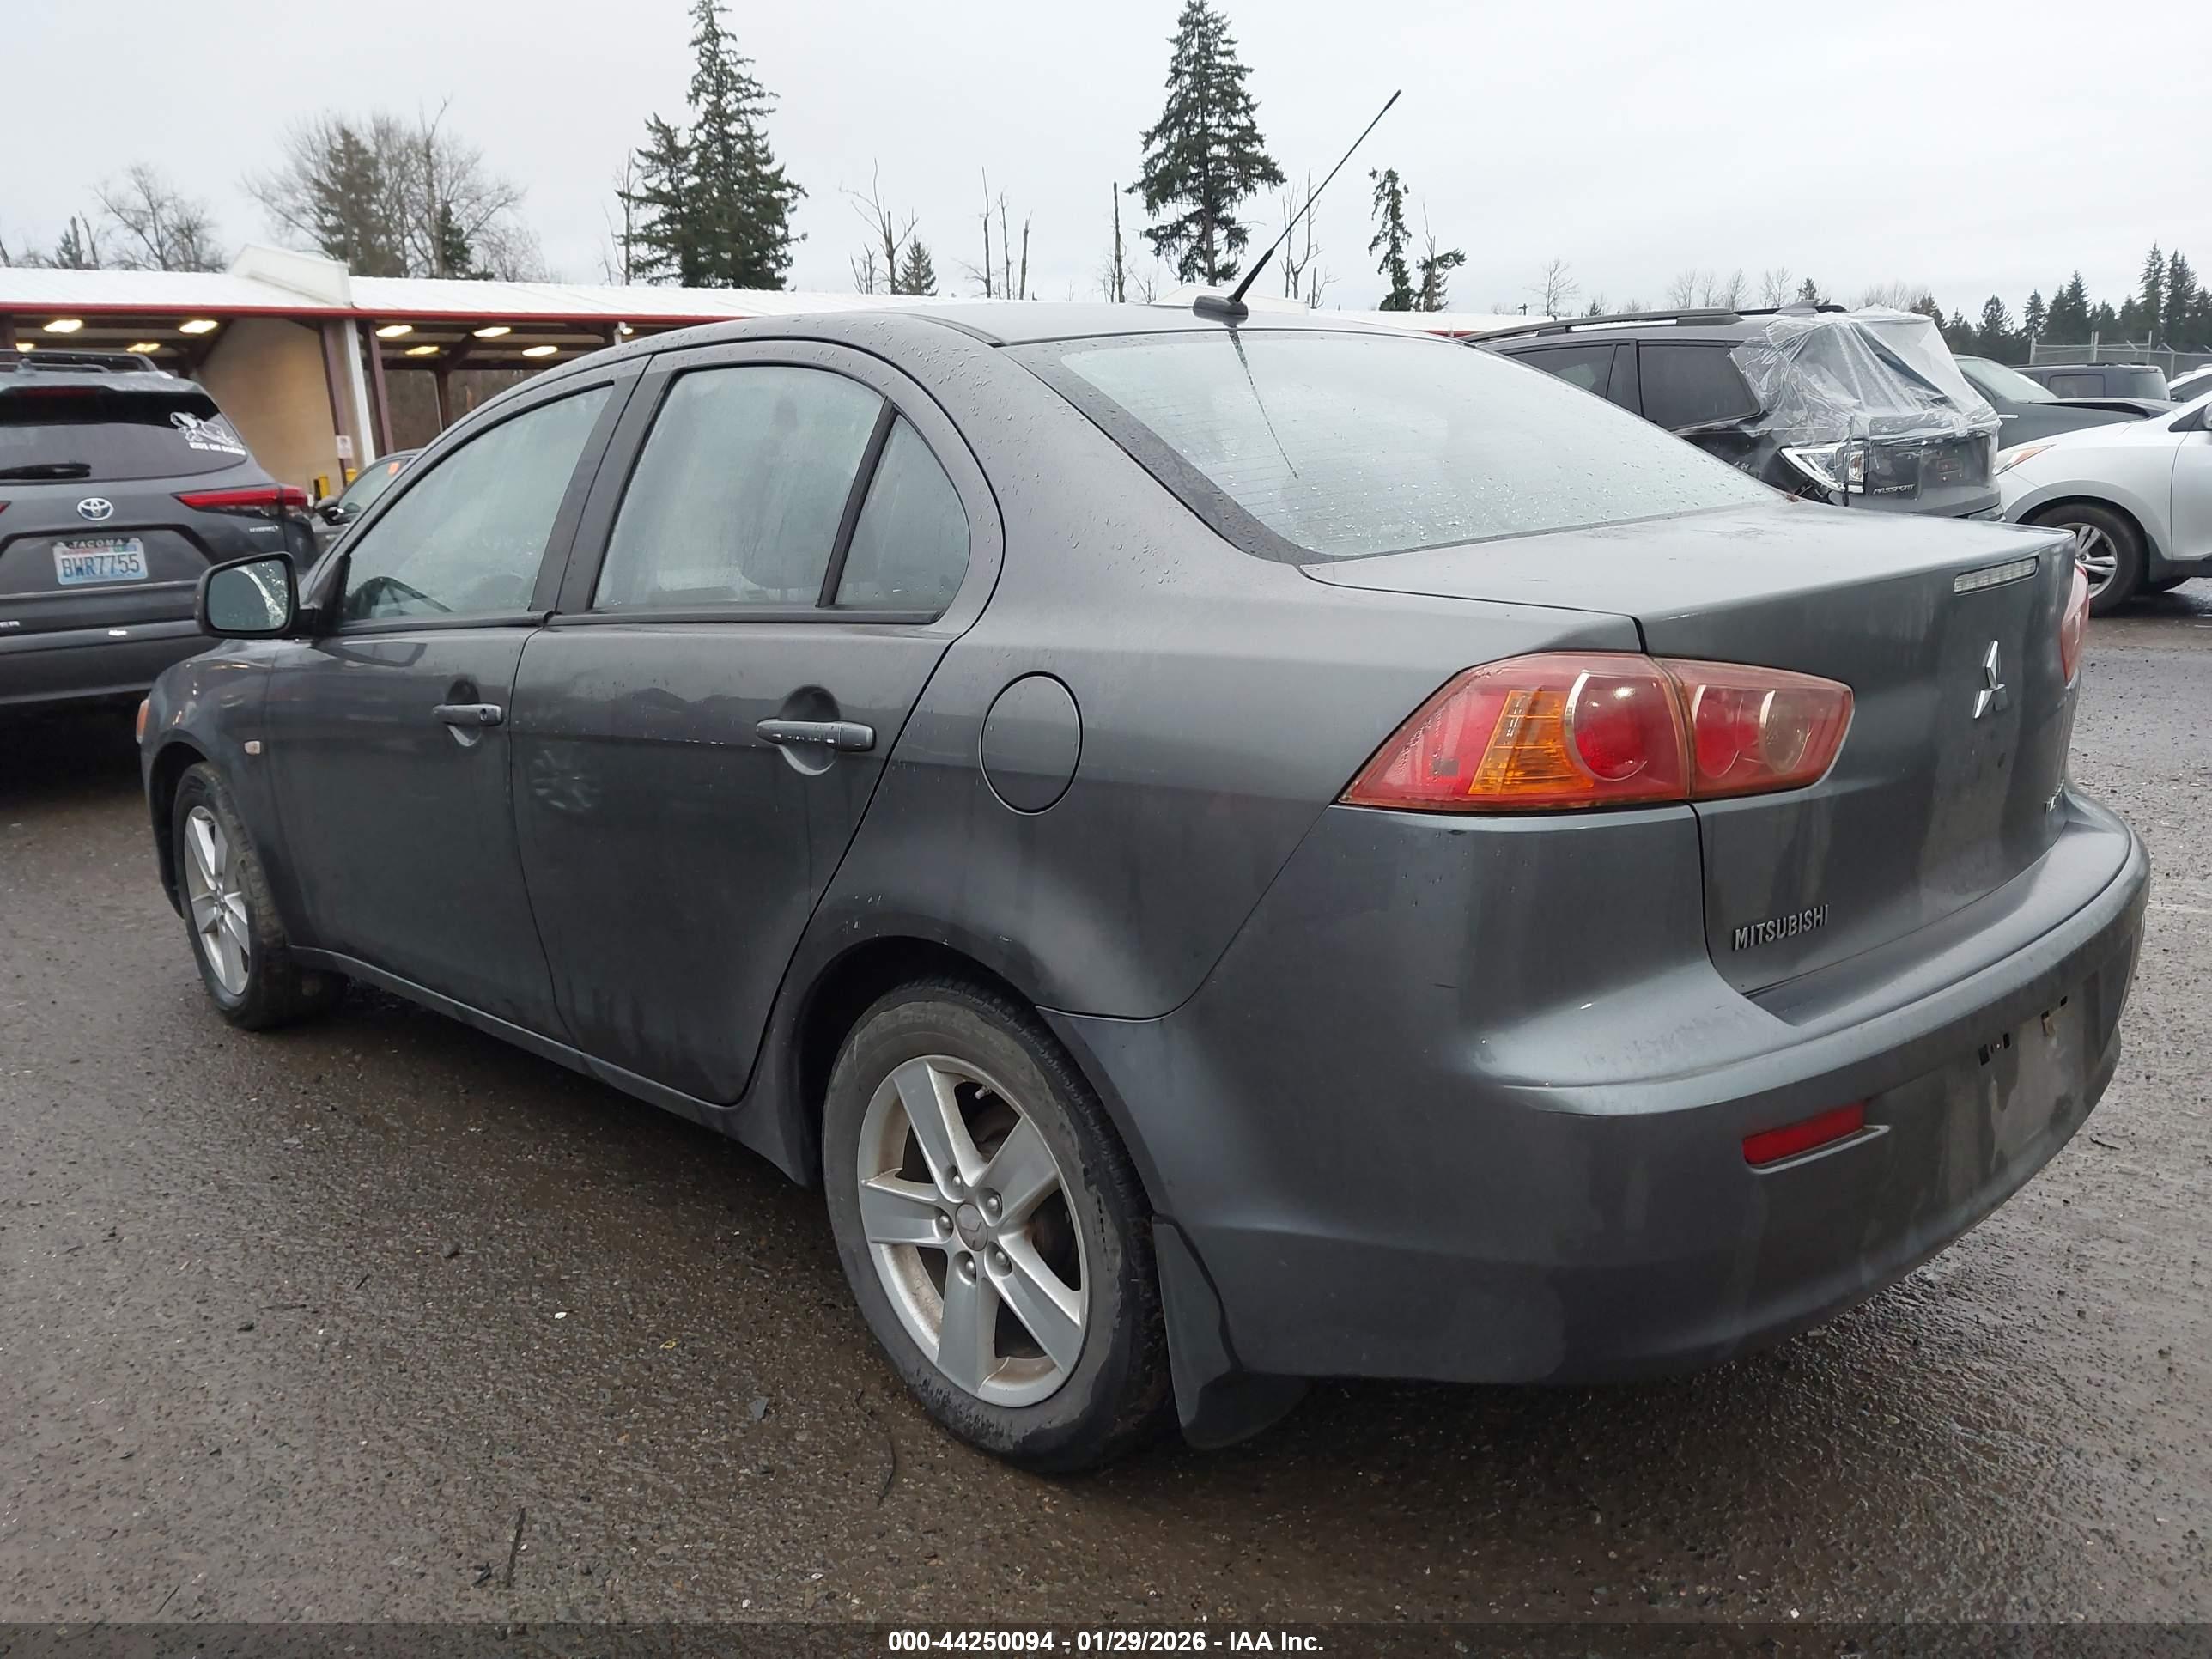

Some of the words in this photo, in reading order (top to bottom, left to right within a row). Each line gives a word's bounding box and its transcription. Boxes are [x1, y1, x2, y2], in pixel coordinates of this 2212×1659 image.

[71, 538, 124, 549] TACOMA
[61, 554, 141, 578] BWR7755
[1733, 904, 1829, 951] MITSUBISHI
